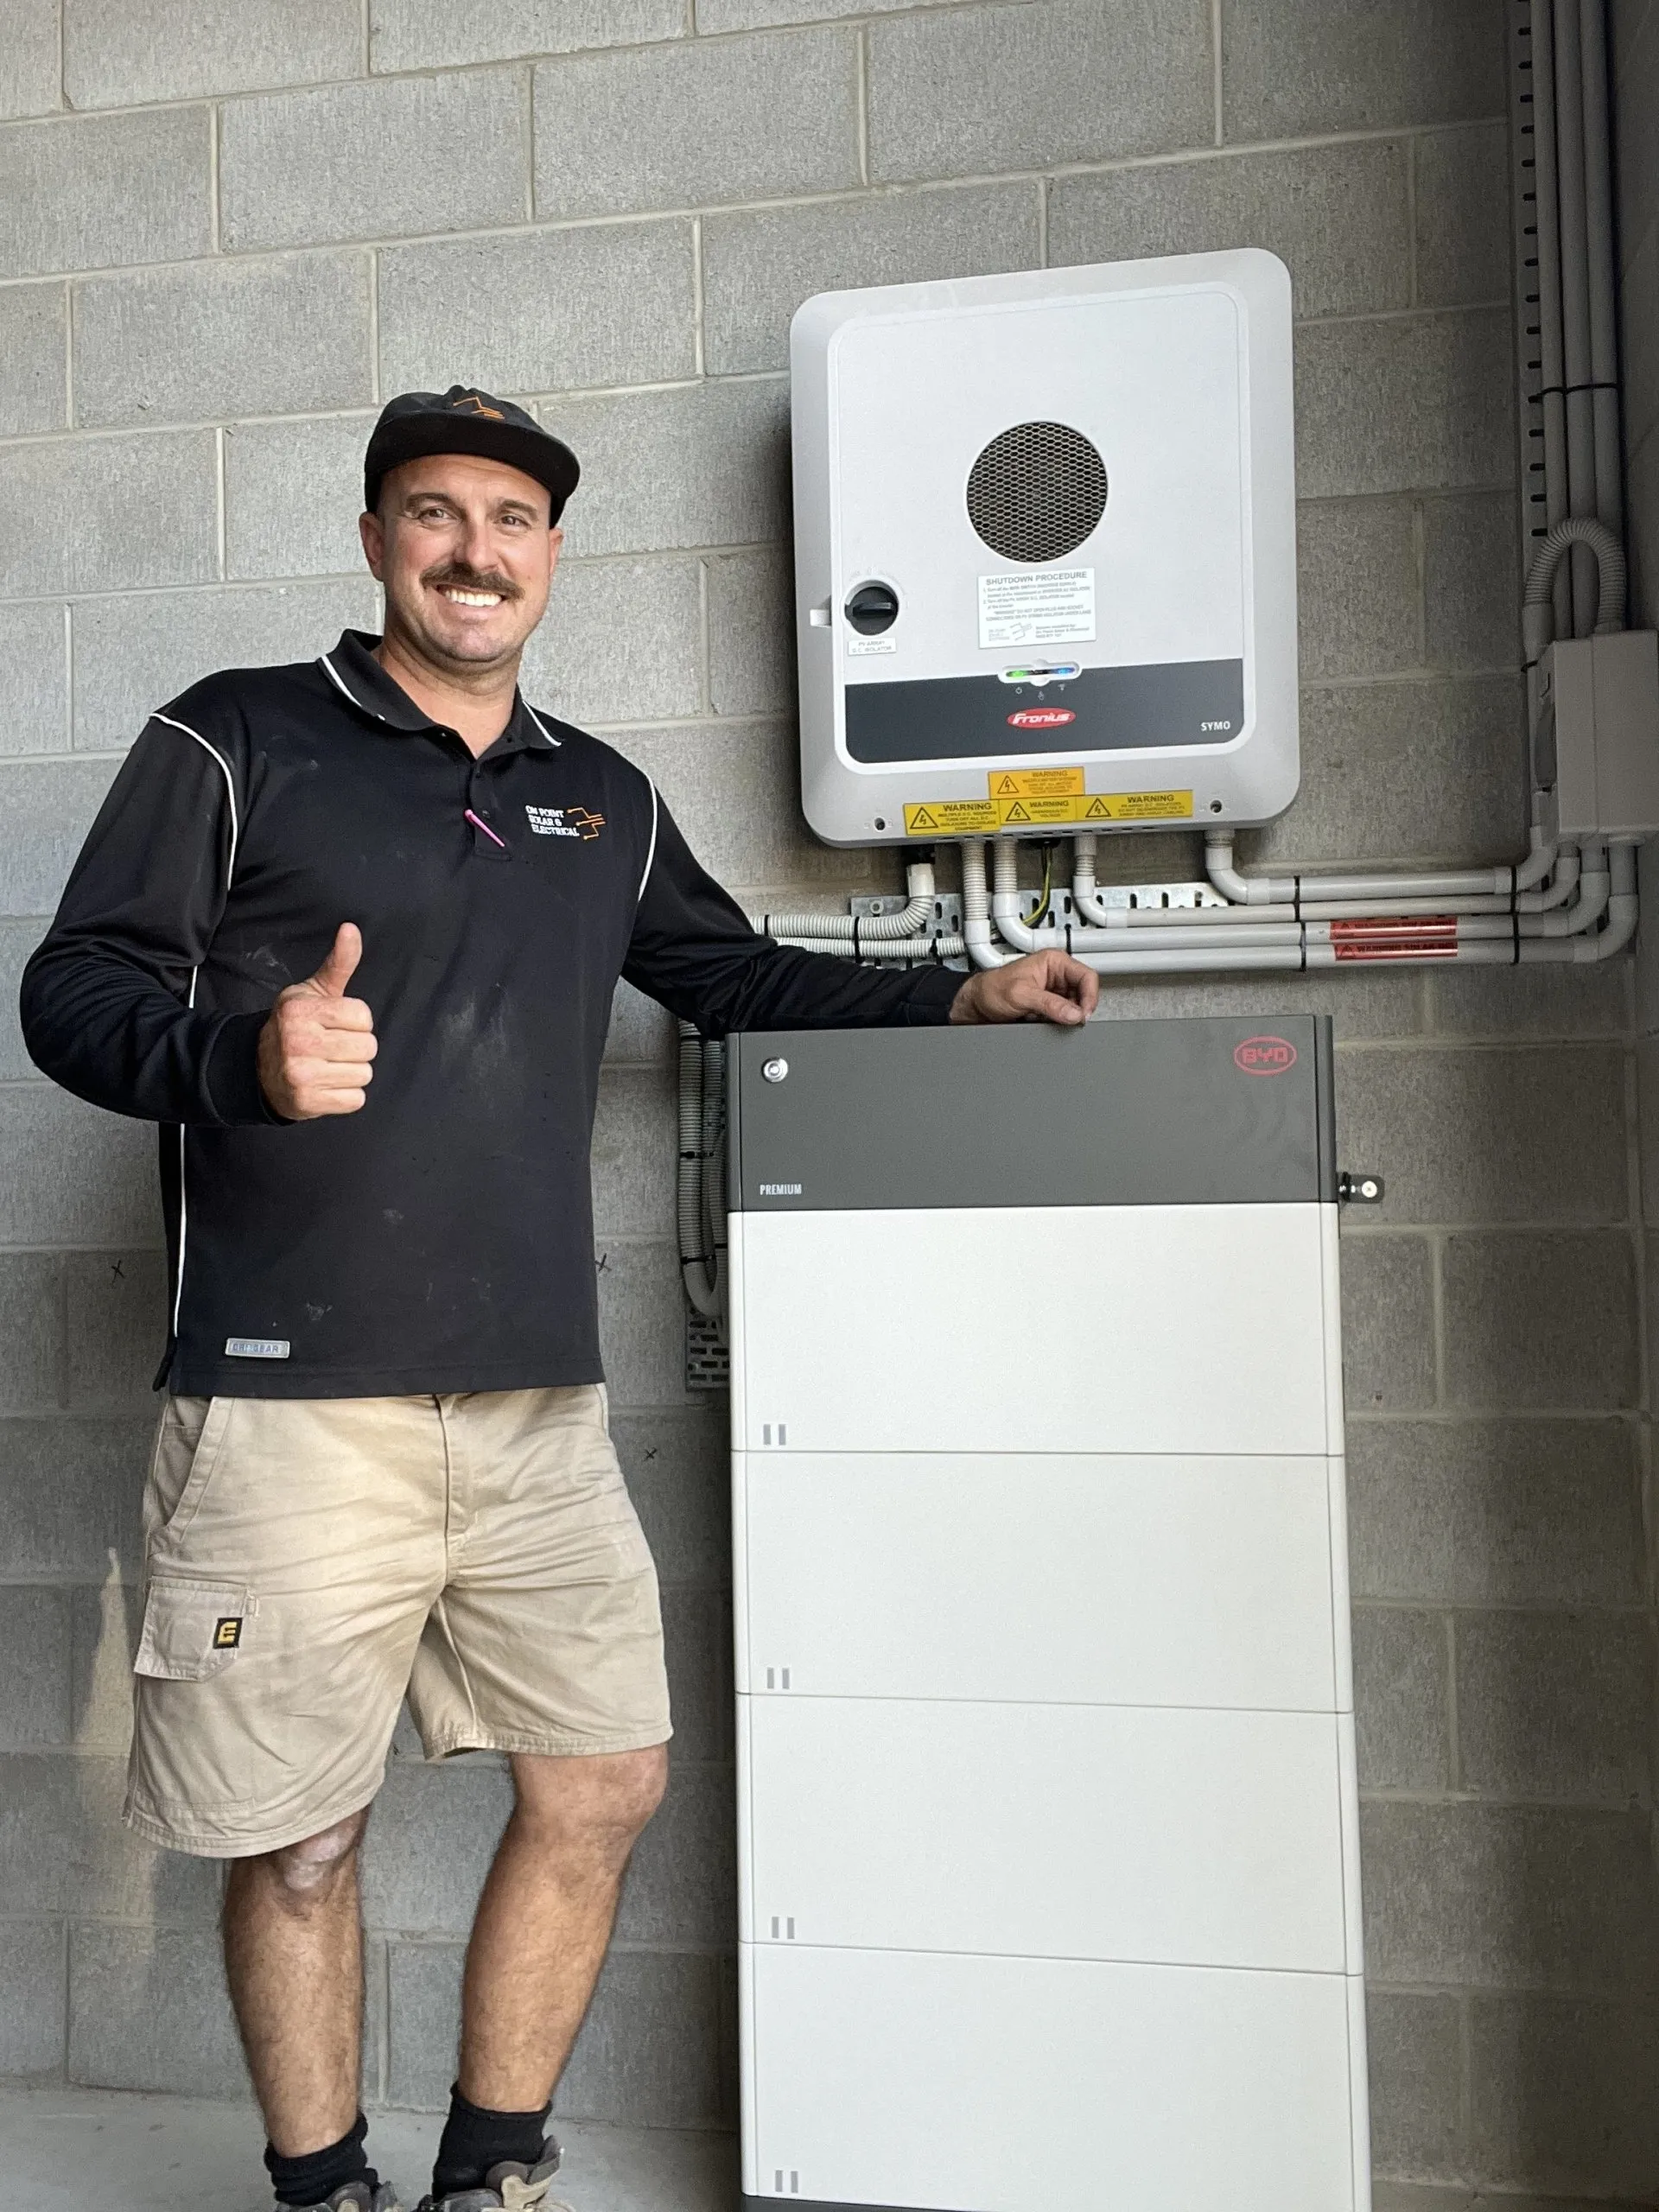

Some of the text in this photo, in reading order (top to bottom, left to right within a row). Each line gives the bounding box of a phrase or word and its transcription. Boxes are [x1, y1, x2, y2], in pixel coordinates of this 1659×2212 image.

[986, 571, 1087, 585] SHUTDOWN PROCEDURE
[1012, 711, 1071, 725] Fronius
[1200, 721, 1231, 732] SYMO
[1029, 799, 1069, 808] WARNING
[1128, 794, 1174, 803] WARNING
[525, 804, 564, 818] ON POINT
[943, 803, 993, 811] WARNING
[528, 814, 555, 826] SOLAR
[531, 823, 580, 836] ELECTRICAL
[1242, 1046, 1287, 1064] BYD
[760, 1184, 802, 1195] PREMIUM
[218, 1622, 237, 1644] E
